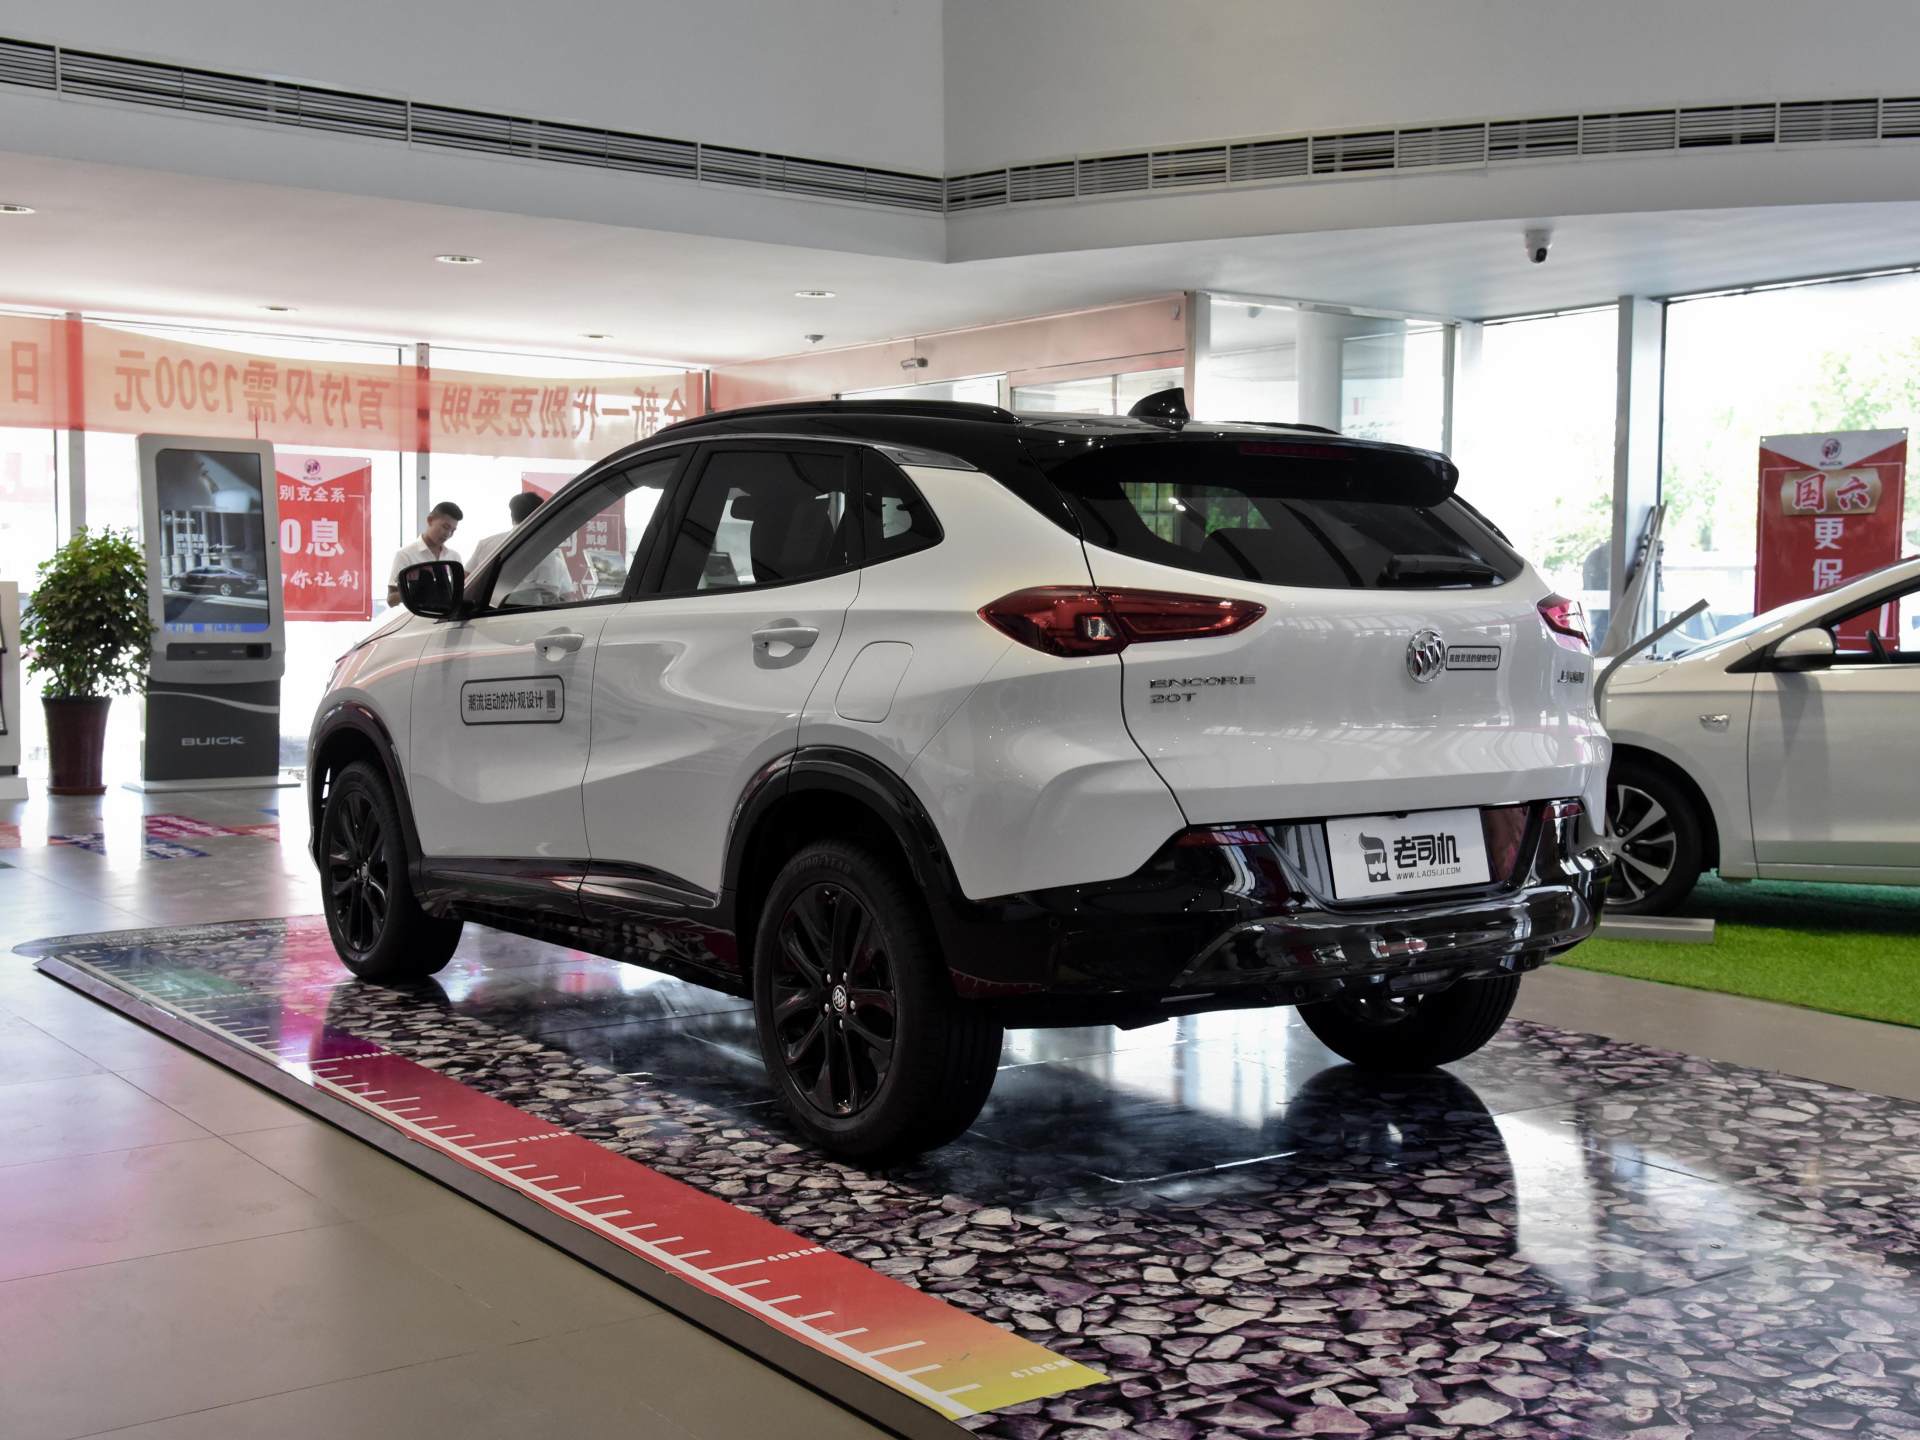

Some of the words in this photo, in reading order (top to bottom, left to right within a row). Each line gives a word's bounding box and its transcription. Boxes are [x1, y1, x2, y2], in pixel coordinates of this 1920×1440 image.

[279, 485, 346, 503] 别克全系
[1792, 471, 1870, 512] 国六
[281, 569, 360, 590] 你让利
[1149, 675, 1257, 689] ENCORE
[1149, 692, 1198, 704] 20T
[181, 737, 247, 747] BUICK
[1393, 832, 1461, 869] 老司机
[1396, 866, 1462, 880] WWW.LAOSIJI.COM
